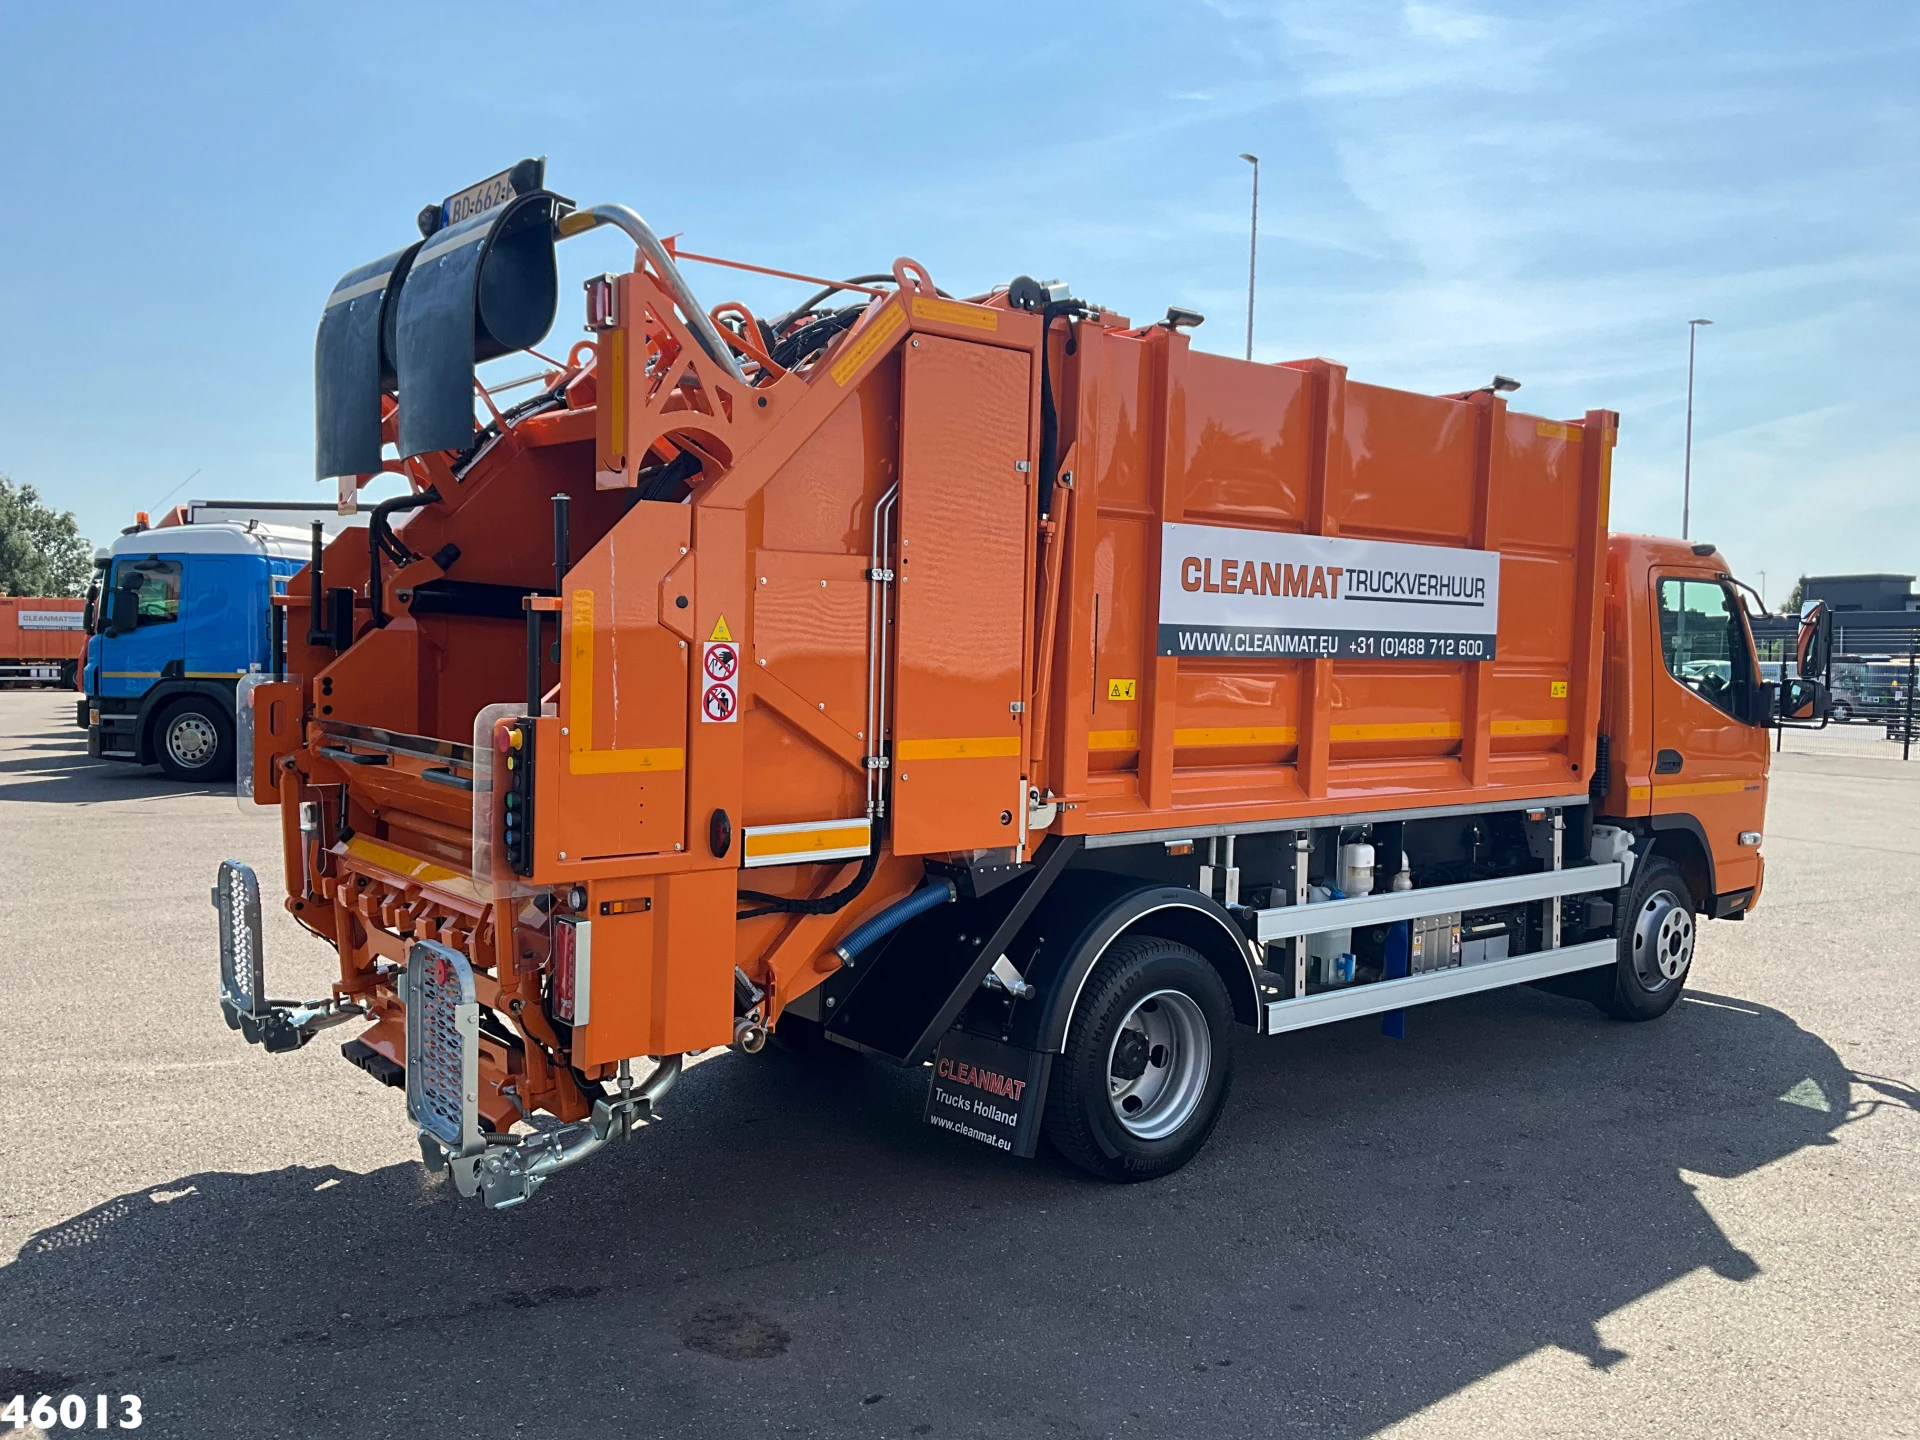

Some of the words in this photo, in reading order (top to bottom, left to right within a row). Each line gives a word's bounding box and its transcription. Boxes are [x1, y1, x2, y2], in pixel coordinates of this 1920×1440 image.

[1181, 556, 1344, 600] CLEANMAT
[1345, 568, 1485, 599] TRUCKVERHUUR
[1178, 631, 1339, 654] WWW.CLEANMAT.EU
[1349, 636, 1375, 655] +31
[1380, 637, 1425, 657] (0)488
[1429, 639, 1455, 656] 712
[1458, 640, 1483, 656] 600
[937, 1057, 1026, 1102] CLEANMAT
[935, 1087, 971, 1111] Trucks
[973, 1099, 1018, 1127] Holland
[930, 1114, 1012, 1151] www.cleanmat.eu
